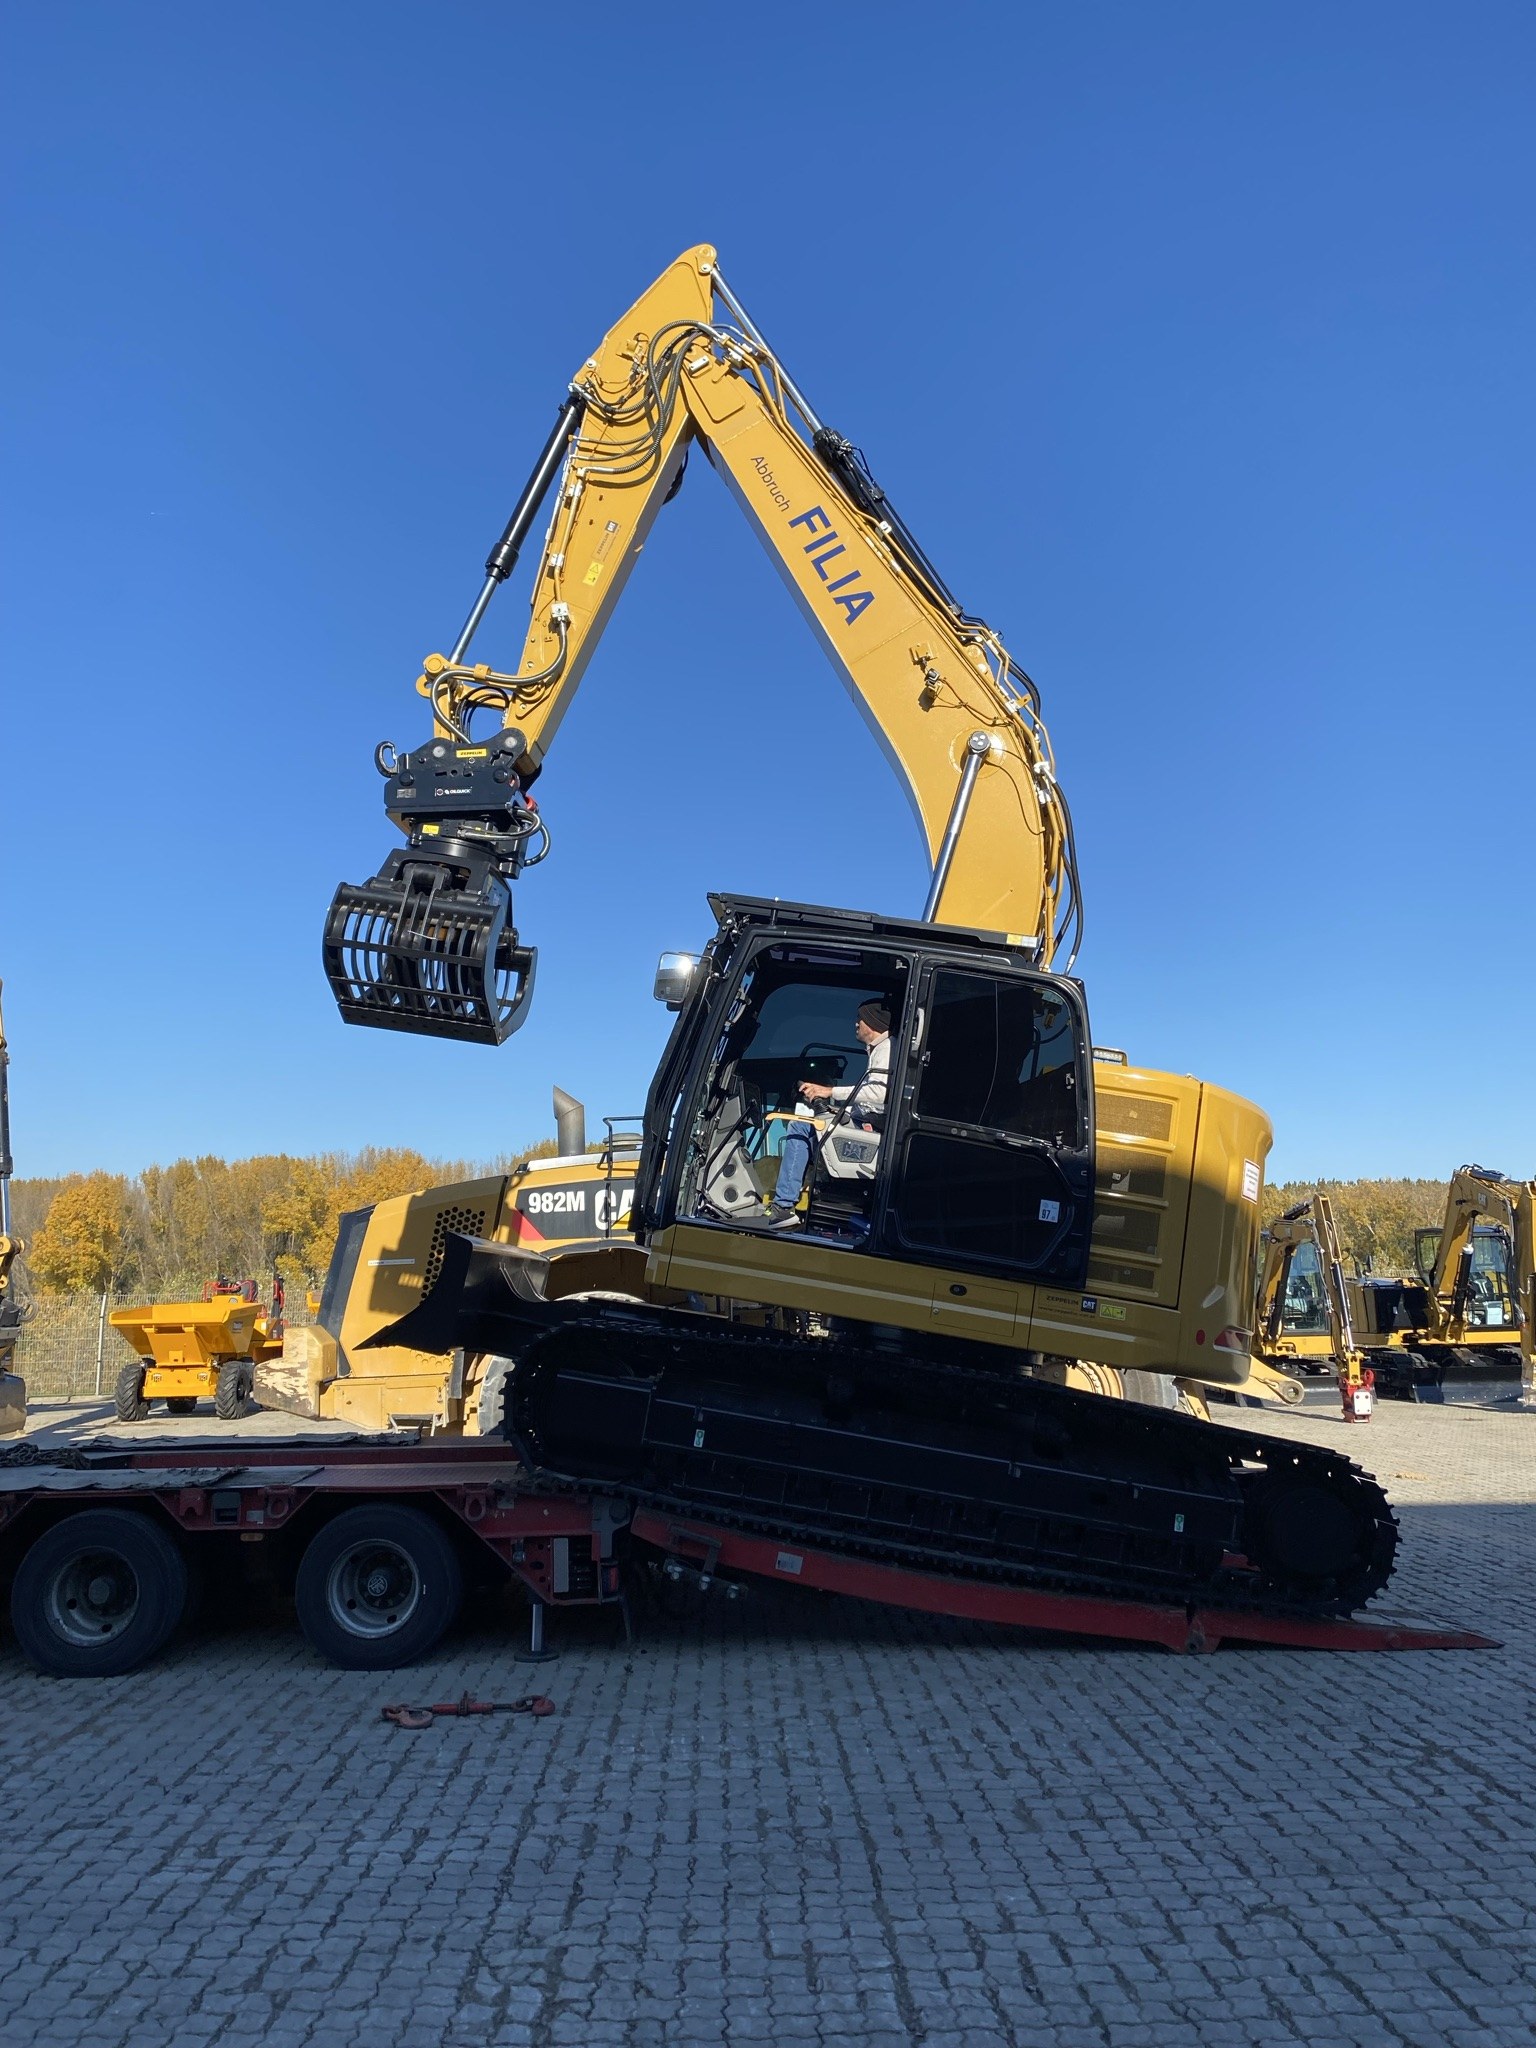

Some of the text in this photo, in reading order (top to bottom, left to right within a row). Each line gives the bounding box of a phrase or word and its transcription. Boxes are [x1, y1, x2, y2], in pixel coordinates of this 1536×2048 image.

[751, 456, 790, 512] Abbruch
[788, 505, 875, 626] FILIA
[528, 1190, 585, 1214] 982M
[1041, 1208, 1051, 1220] 97
[1082, 1300, 1096, 1310] CAT
